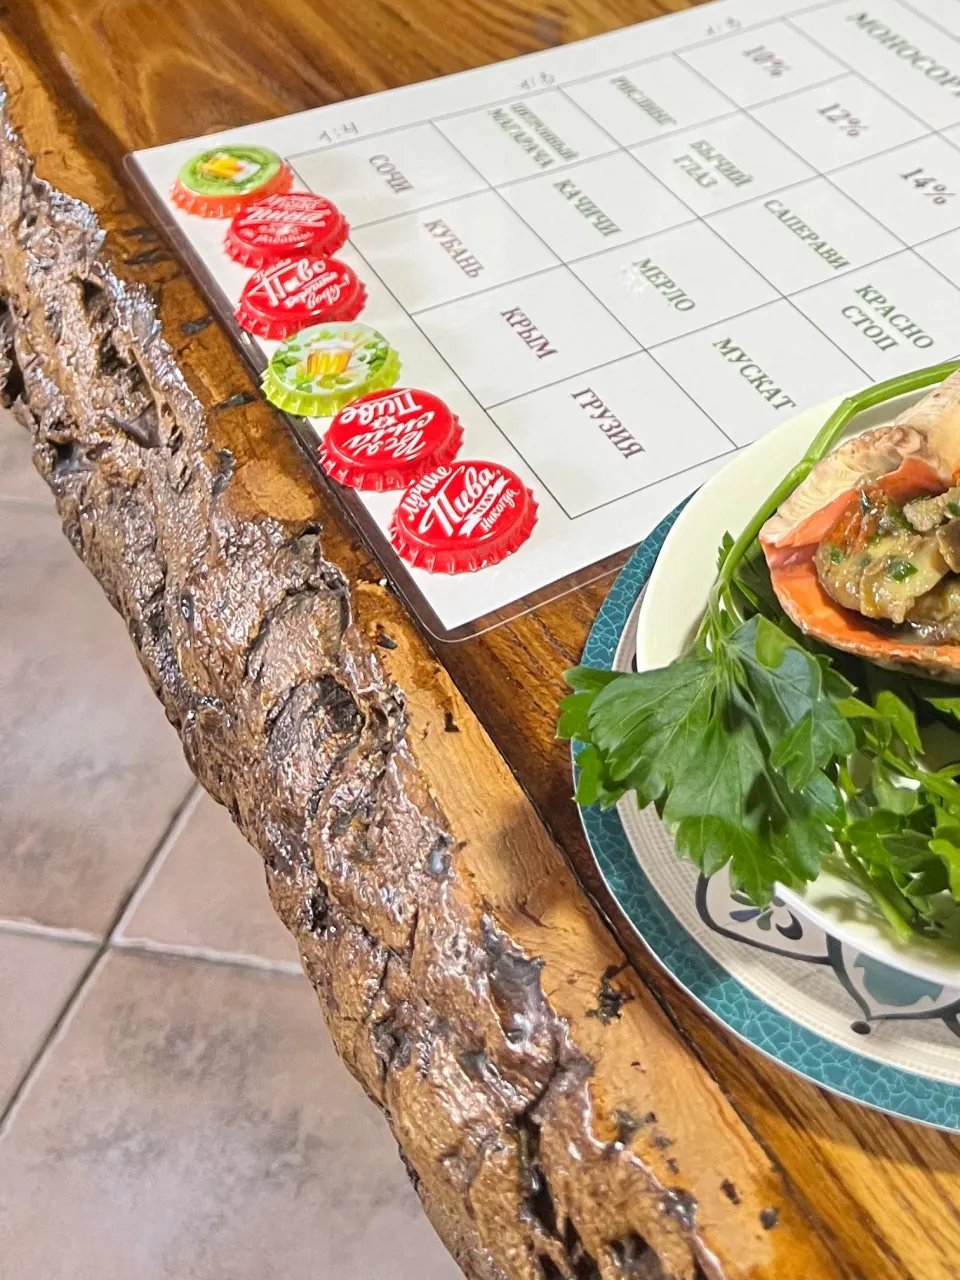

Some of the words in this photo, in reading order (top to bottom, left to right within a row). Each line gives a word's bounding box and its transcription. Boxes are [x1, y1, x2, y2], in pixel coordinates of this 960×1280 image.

[815, 101, 872, 138] 12%
[369, 153, 415, 194] СОЧИ
[672, 156, 718, 189] ГЛАЗ
[690, 138, 756, 187] БЫЧИЙ
[899, 167, 957, 206] 14%
[553, 179, 622, 237] КАЧИЧИ
[423, 218, 485, 280] КУБАНЬ
[764, 198, 850, 271] САПЕРАВИ
[247, 258, 326, 307] Пиво
[633, 258, 697, 313] МЕРЛО
[500, 306, 559, 360] КРЫМ
[841, 304, 900, 353] СТОП
[854, 284, 935, 350] КРАСНО
[712, 337, 796, 411] МУСКАТ
[340, 391, 422, 424] Пиве
[571, 387, 647, 460] ГРУЗИЯ
[353, 430, 426, 458] Вся
